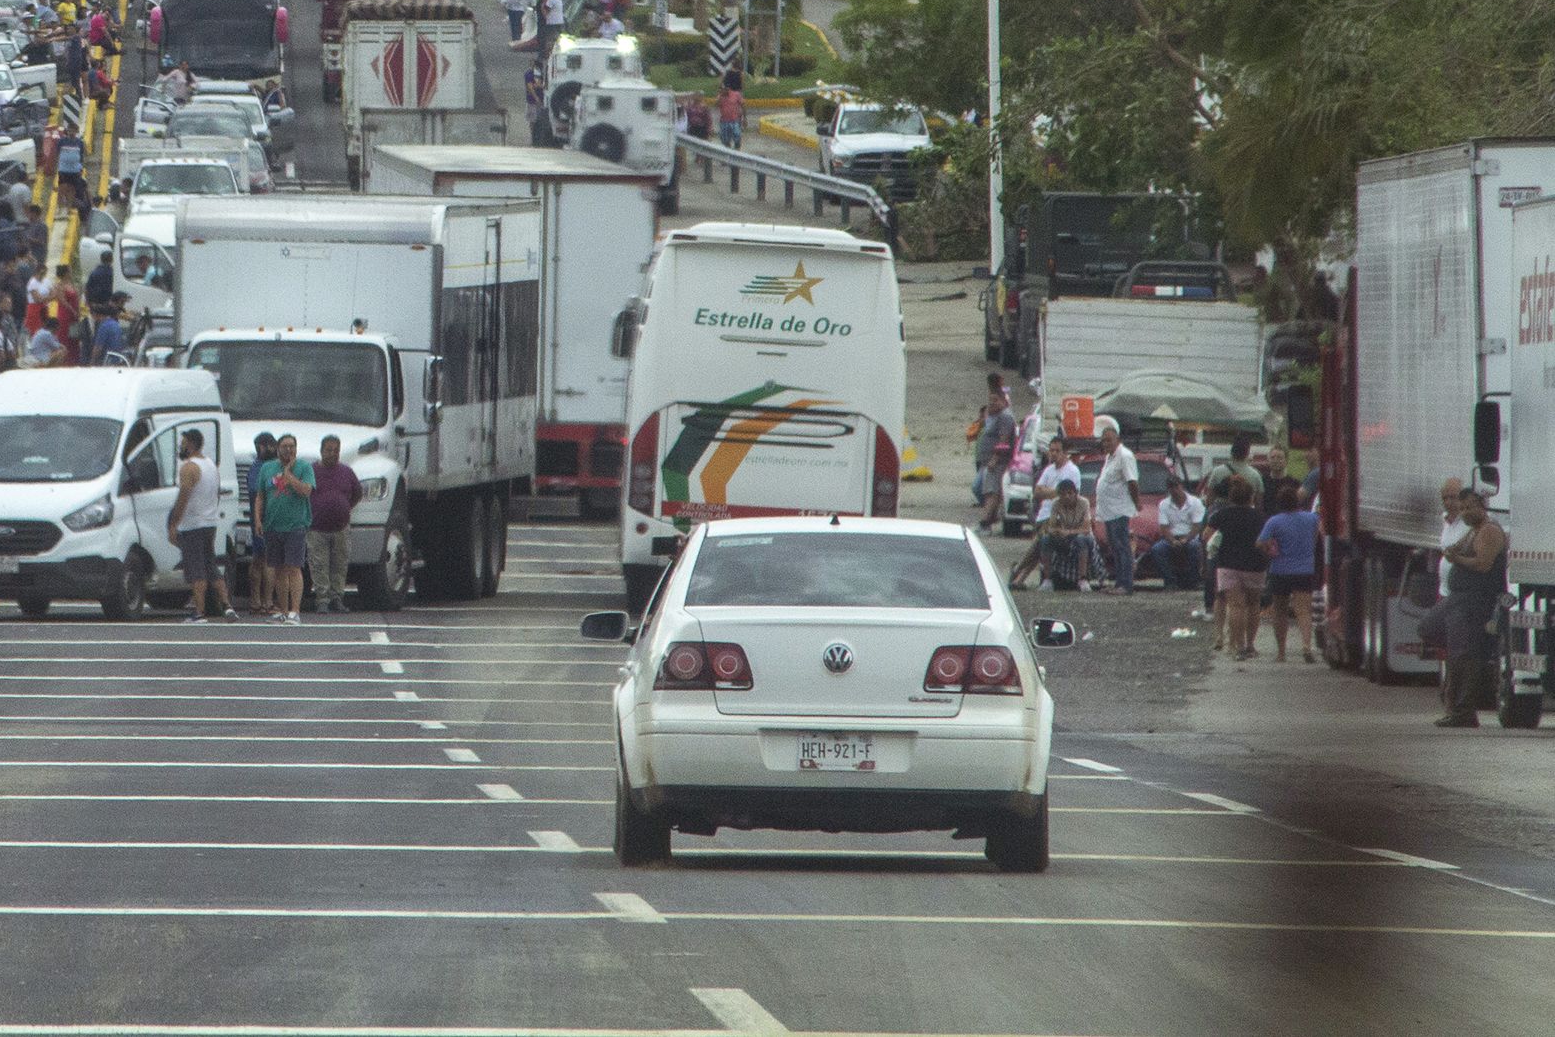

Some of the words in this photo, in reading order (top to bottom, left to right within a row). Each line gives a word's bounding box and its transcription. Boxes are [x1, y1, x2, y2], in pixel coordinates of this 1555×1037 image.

[694, 308, 774, 331] Estrella
[780, 315, 806, 333] de
[813, 317, 852, 337] Oro
[801, 742, 873, 759] HEH-921-F
